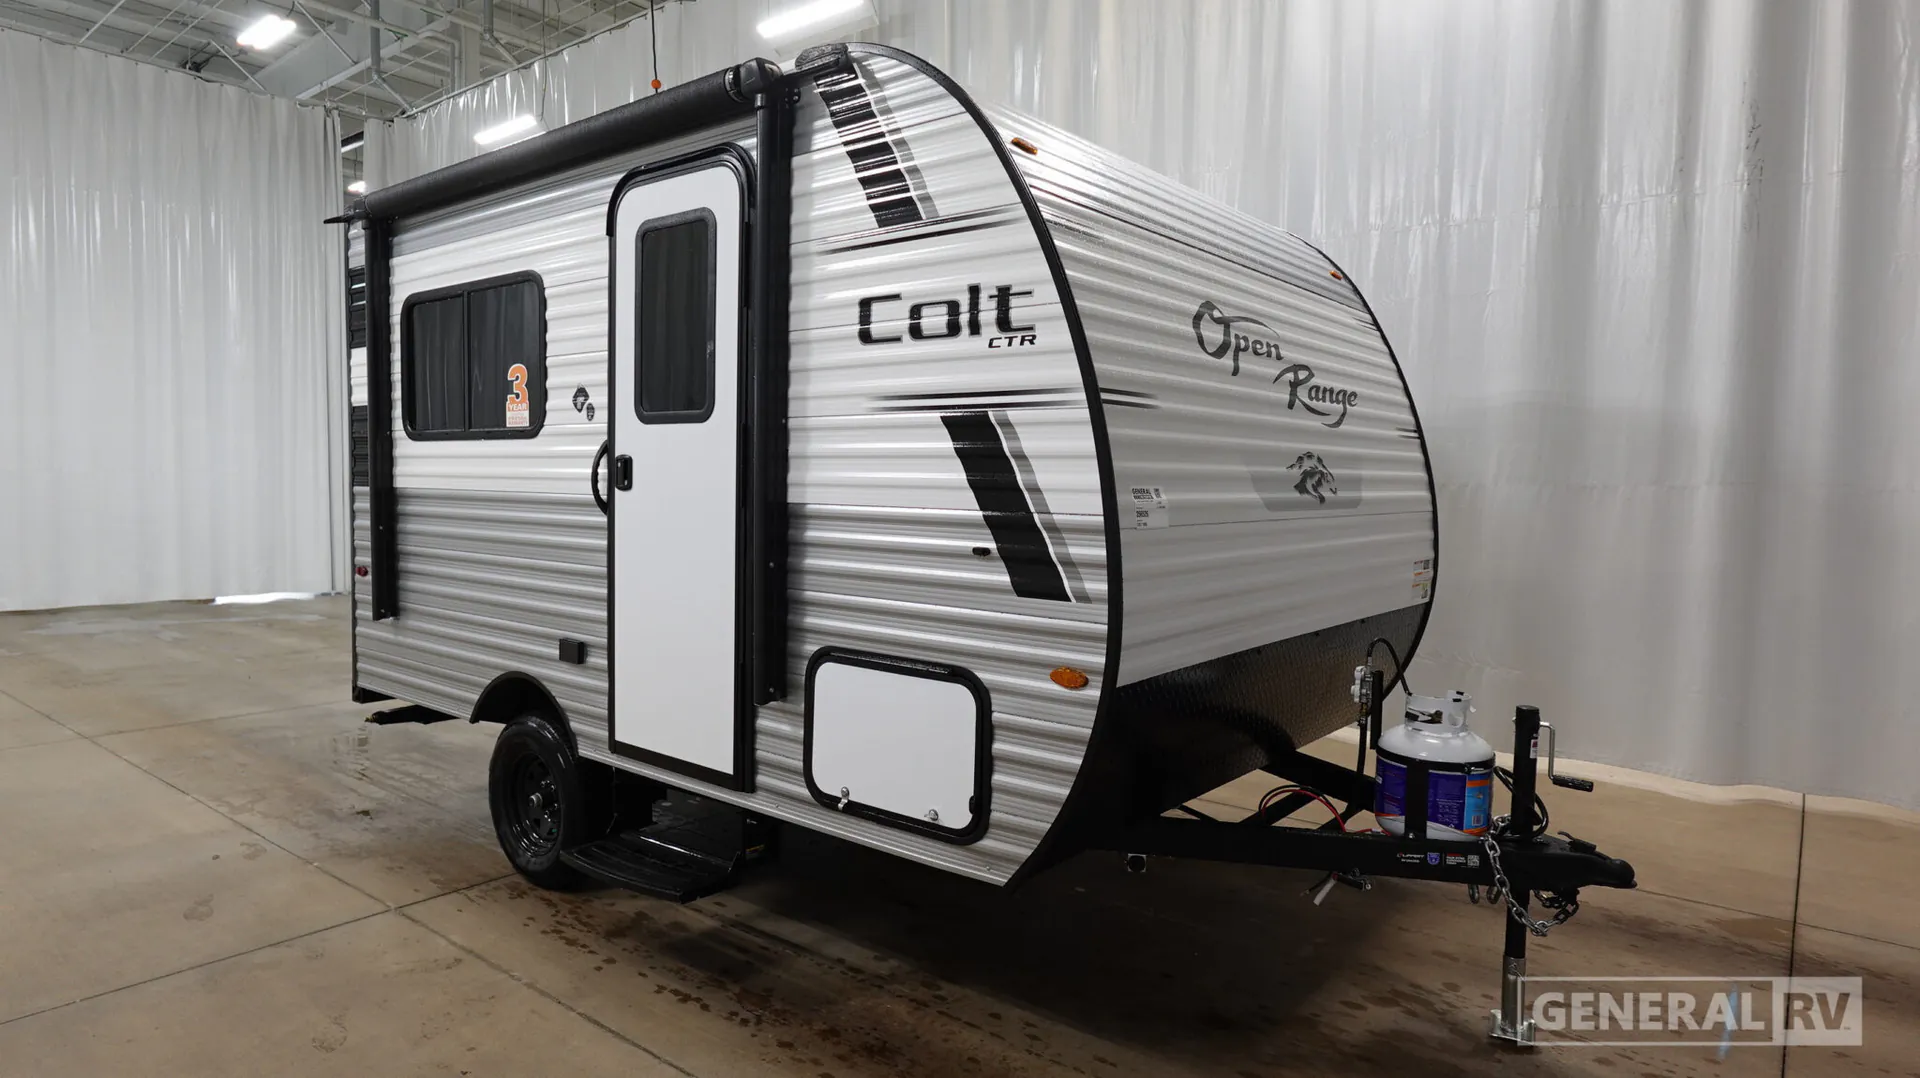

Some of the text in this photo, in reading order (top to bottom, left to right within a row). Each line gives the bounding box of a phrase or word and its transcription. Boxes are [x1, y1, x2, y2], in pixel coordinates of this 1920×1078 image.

[858, 283, 1036, 346] Colt
[1192, 301, 1284, 376] Open
[988, 334, 1037, 348] CTR
[507, 363, 528, 403] 3
[509, 403, 528, 411] YEAR
[1273, 364, 1358, 428] Range
